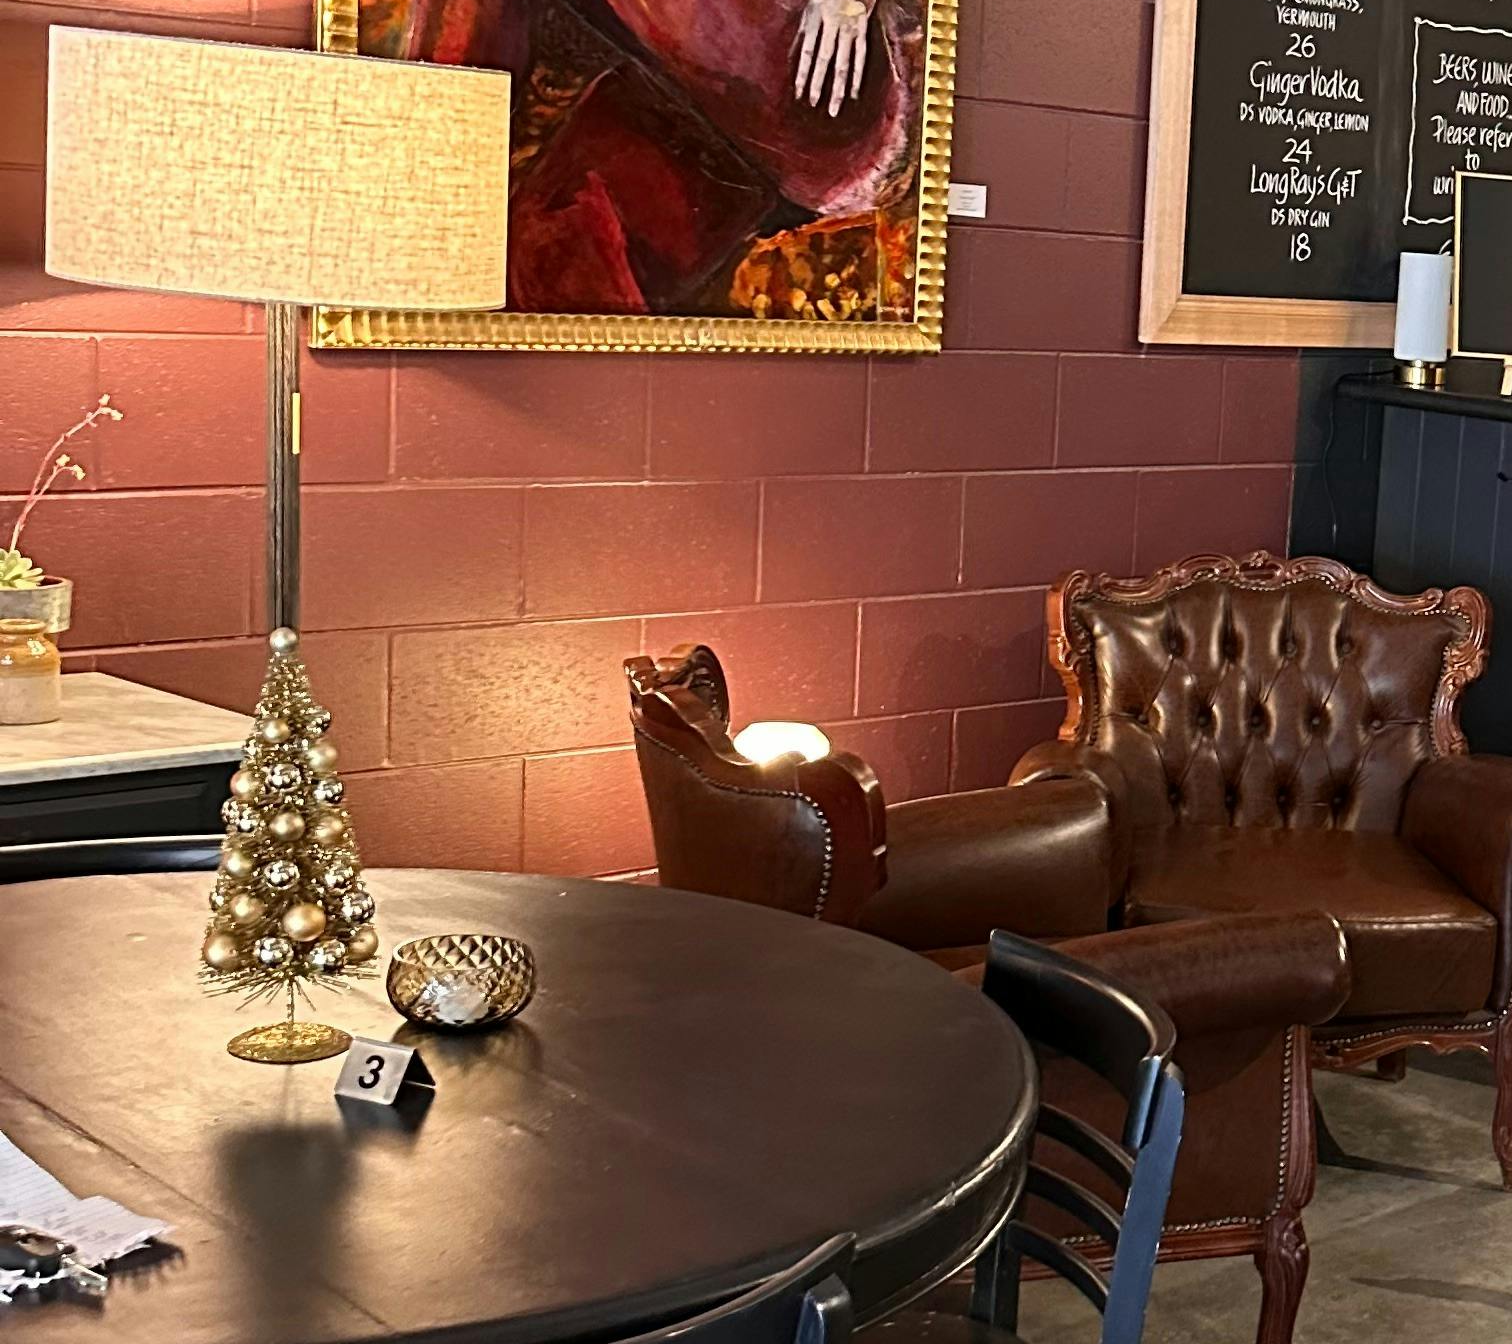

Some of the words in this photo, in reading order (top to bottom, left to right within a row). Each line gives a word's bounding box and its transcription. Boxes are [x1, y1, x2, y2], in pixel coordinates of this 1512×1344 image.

[1276, 5, 1336, 31] VERMOUTH
[1285, 33, 1316, 58] 26
[1250, 60, 1309, 106] Ginger
[1311, 66, 1364, 103] Vodka
[1432, 53, 1479, 88] BEERS,
[1456, 90, 1479, 115] AND
[1240, 102, 1254, 122] DS
[1259, 107, 1297, 132] VODKA,
[1297, 108, 1333, 135] GINGER,
[1334, 114, 1369, 132] LEMON
[1430, 115, 1477, 146] Please
[1282, 138, 1312, 164] 24
[1464, 148, 1480, 171] to
[1327, 167, 1362, 205] G&T
[1271, 208, 1285, 226] DS
[1288, 208, 1309, 227] DRY
[1310, 210, 1330, 227] GIN
[1290, 232, 1311, 262] 18
[359, 1055, 385, 1089] 3
